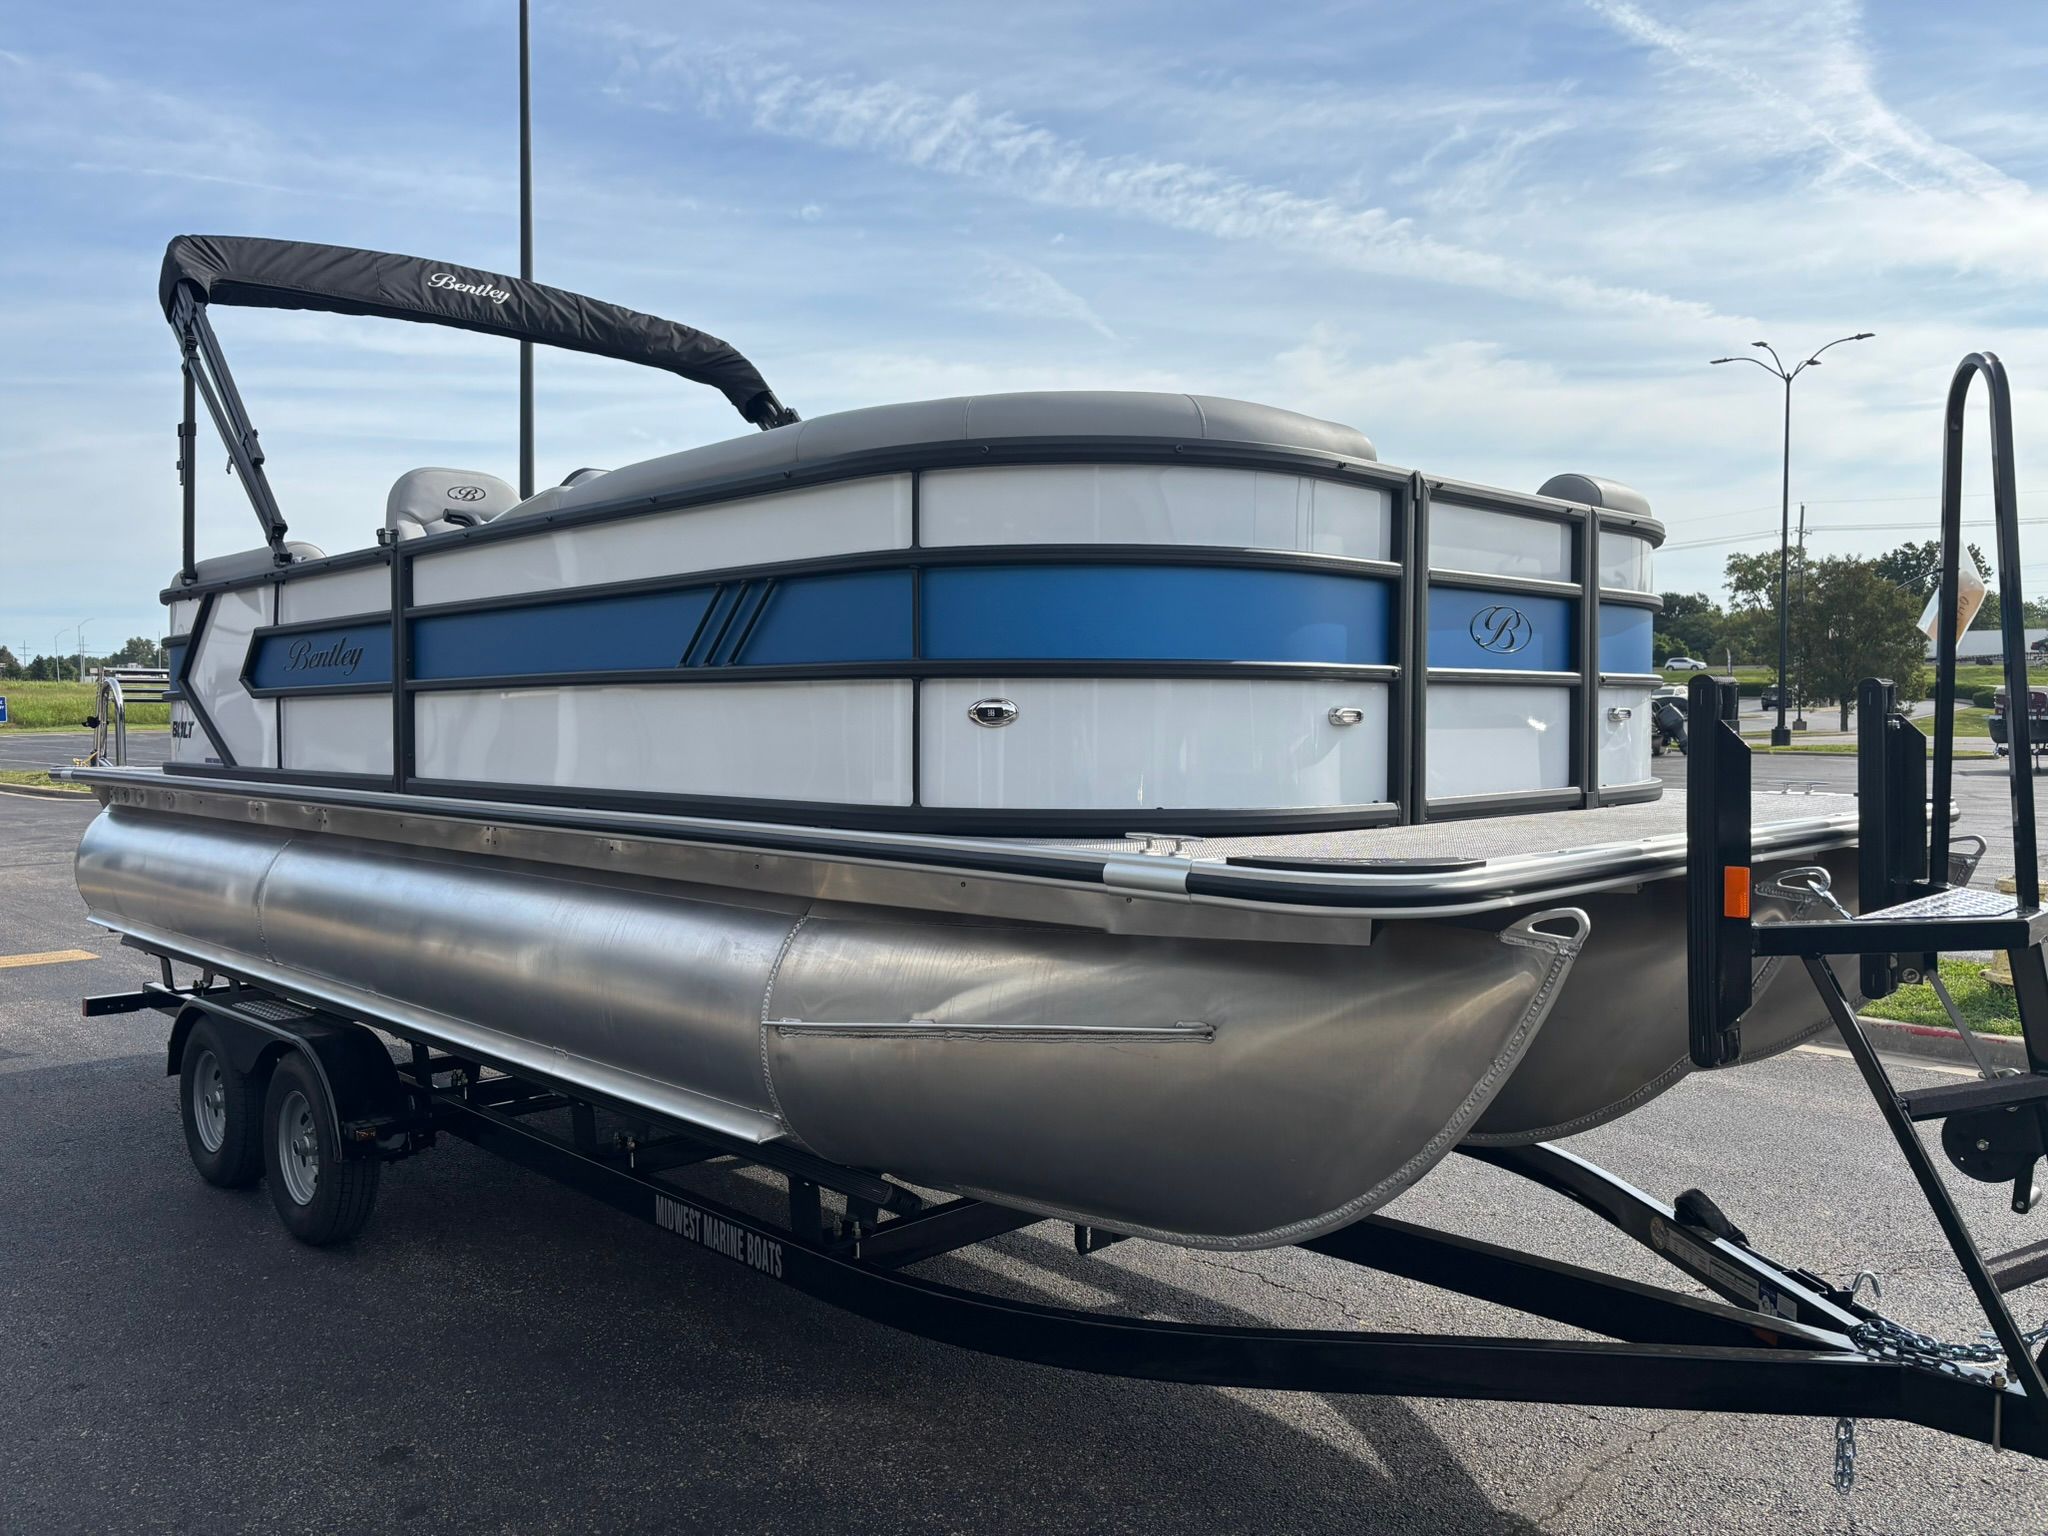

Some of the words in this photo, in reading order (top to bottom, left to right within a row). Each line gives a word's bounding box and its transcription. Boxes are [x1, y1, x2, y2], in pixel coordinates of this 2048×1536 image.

[428, 273, 510, 304] Bentley
[1475, 606, 1521, 650] B
[284, 637, 363, 676] Bentley
[172, 721, 194, 738] BOLT
[656, 1194, 701, 1242] MIDWEST
[703, 1214, 744, 1261] MARINE
[747, 1232, 782, 1279] BOATS
